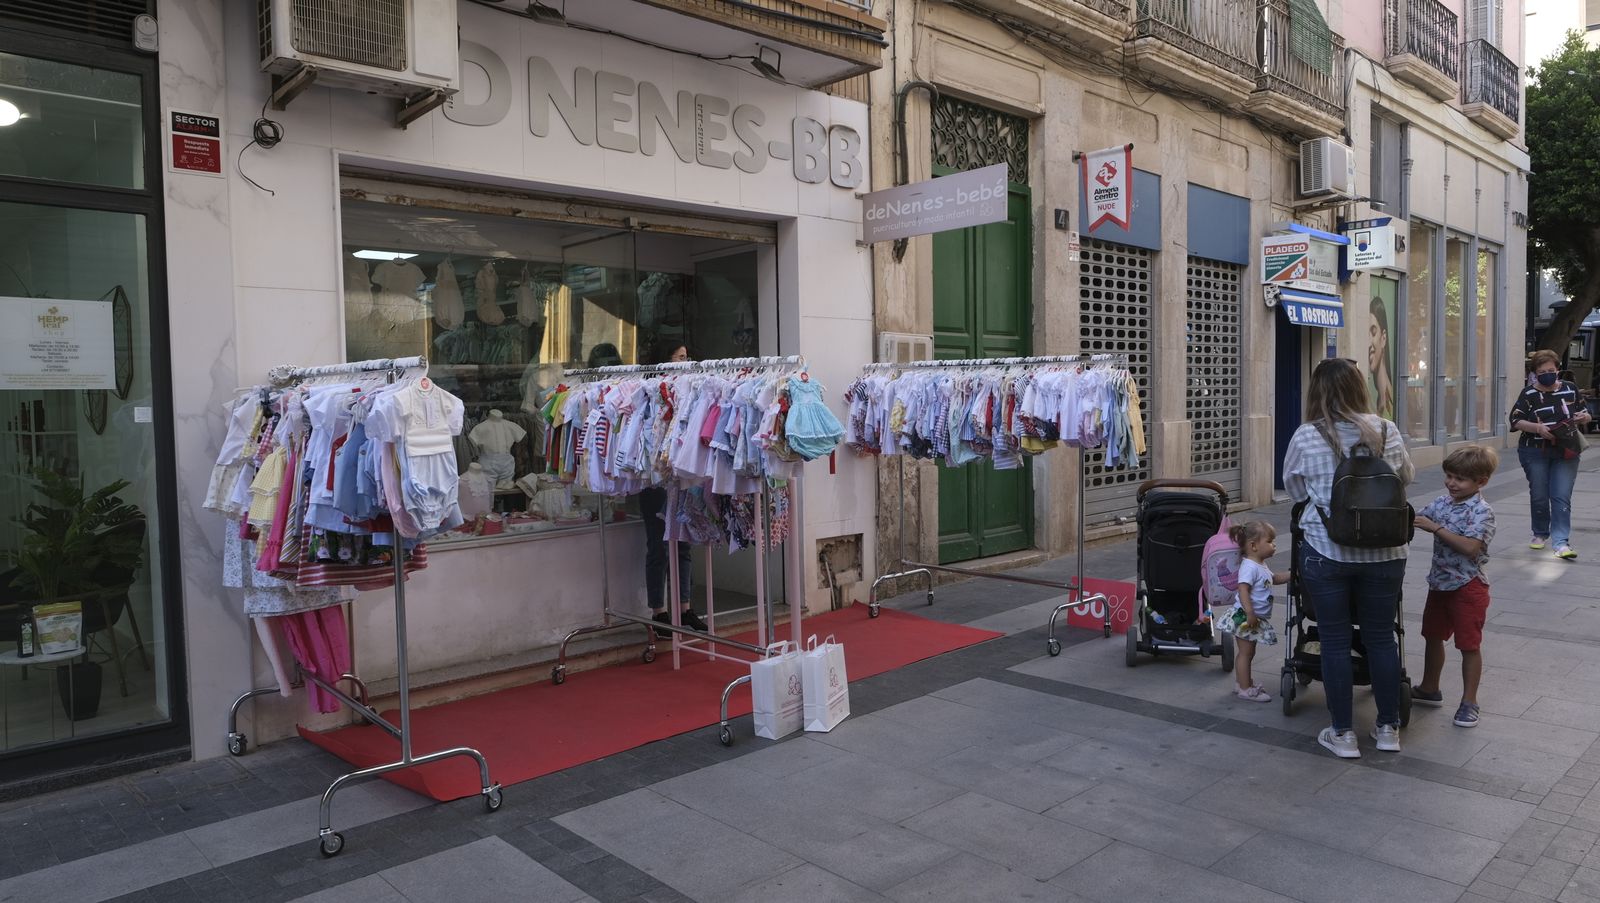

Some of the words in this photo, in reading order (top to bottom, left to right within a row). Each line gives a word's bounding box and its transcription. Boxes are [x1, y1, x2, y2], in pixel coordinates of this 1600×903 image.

[175, 115, 216, 128] SECTOR
[865, 178, 1005, 221] deNenes-bebé
[1094, 192, 1119, 201] centro
[1097, 202, 1116, 211] NUDE
[873, 217, 916, 234] puericultura
[923, 214, 945, 223] moda
[945, 207, 976, 220] infantil
[1058, 210, 1066, 228] 4
[1265, 244, 1306, 255] PLADECO
[38, 315, 69, 324] HEMP
[1287, 305, 1299, 322] EL
